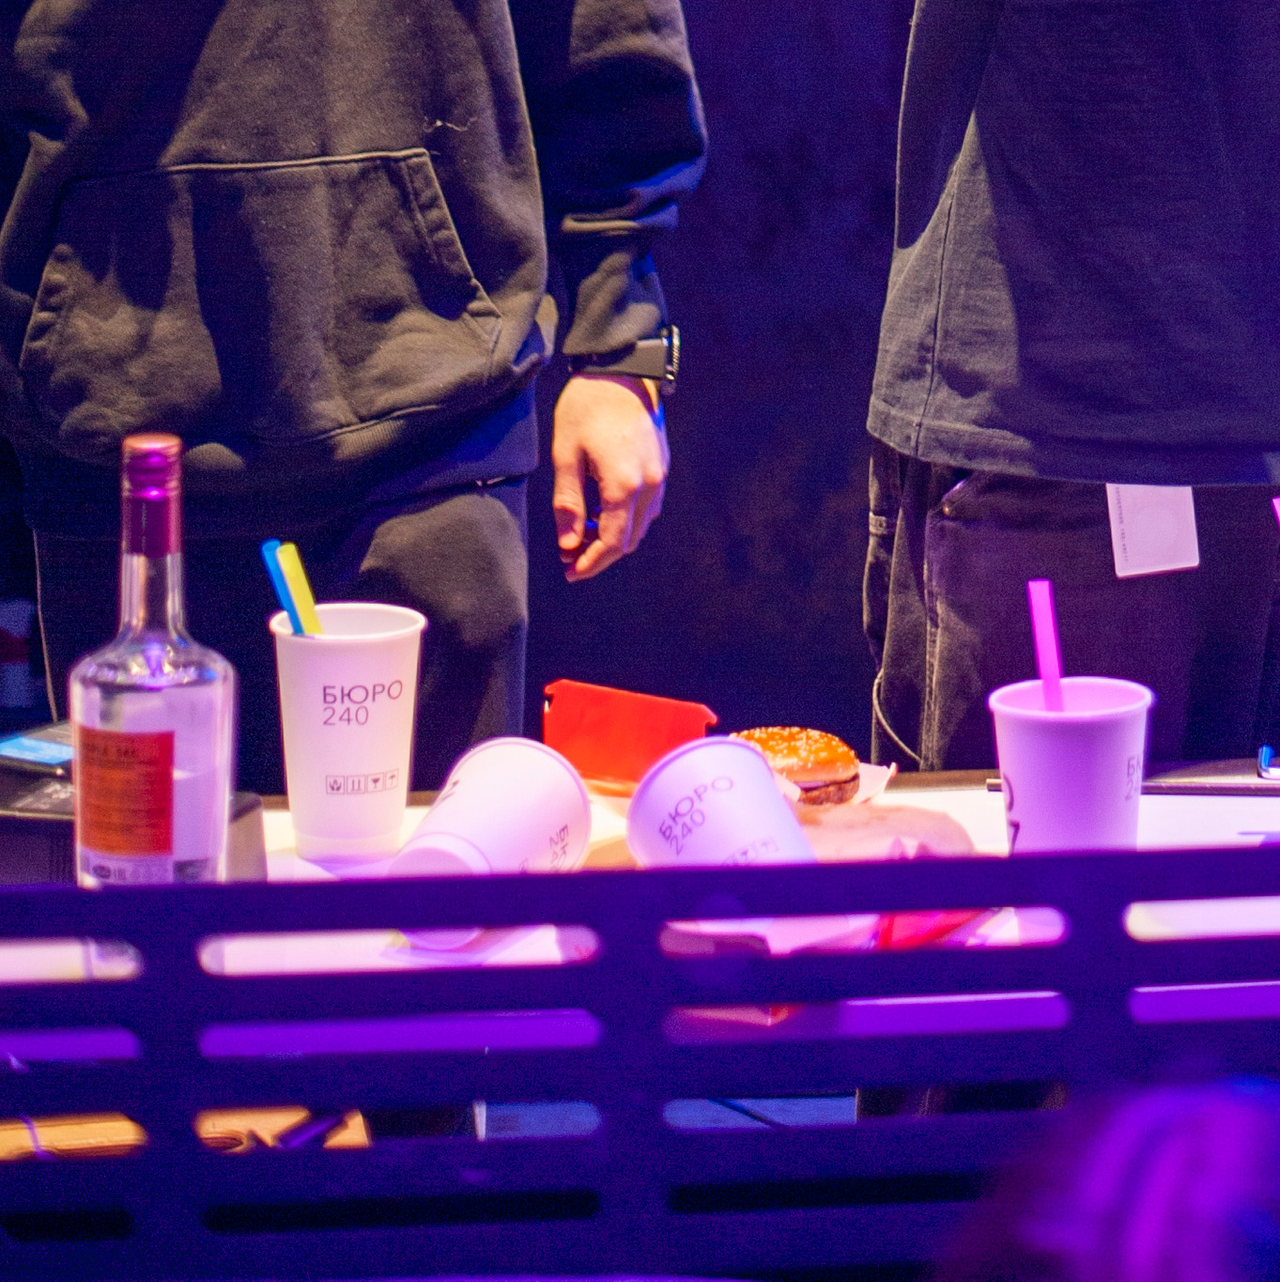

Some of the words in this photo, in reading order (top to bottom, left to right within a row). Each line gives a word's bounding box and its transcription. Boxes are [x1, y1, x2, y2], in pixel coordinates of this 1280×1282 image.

[322, 679, 403, 705] БЮРО
[322, 705, 369, 726] 240
[659, 776, 734, 841] БЮРО
[669, 808, 706, 856] 240
